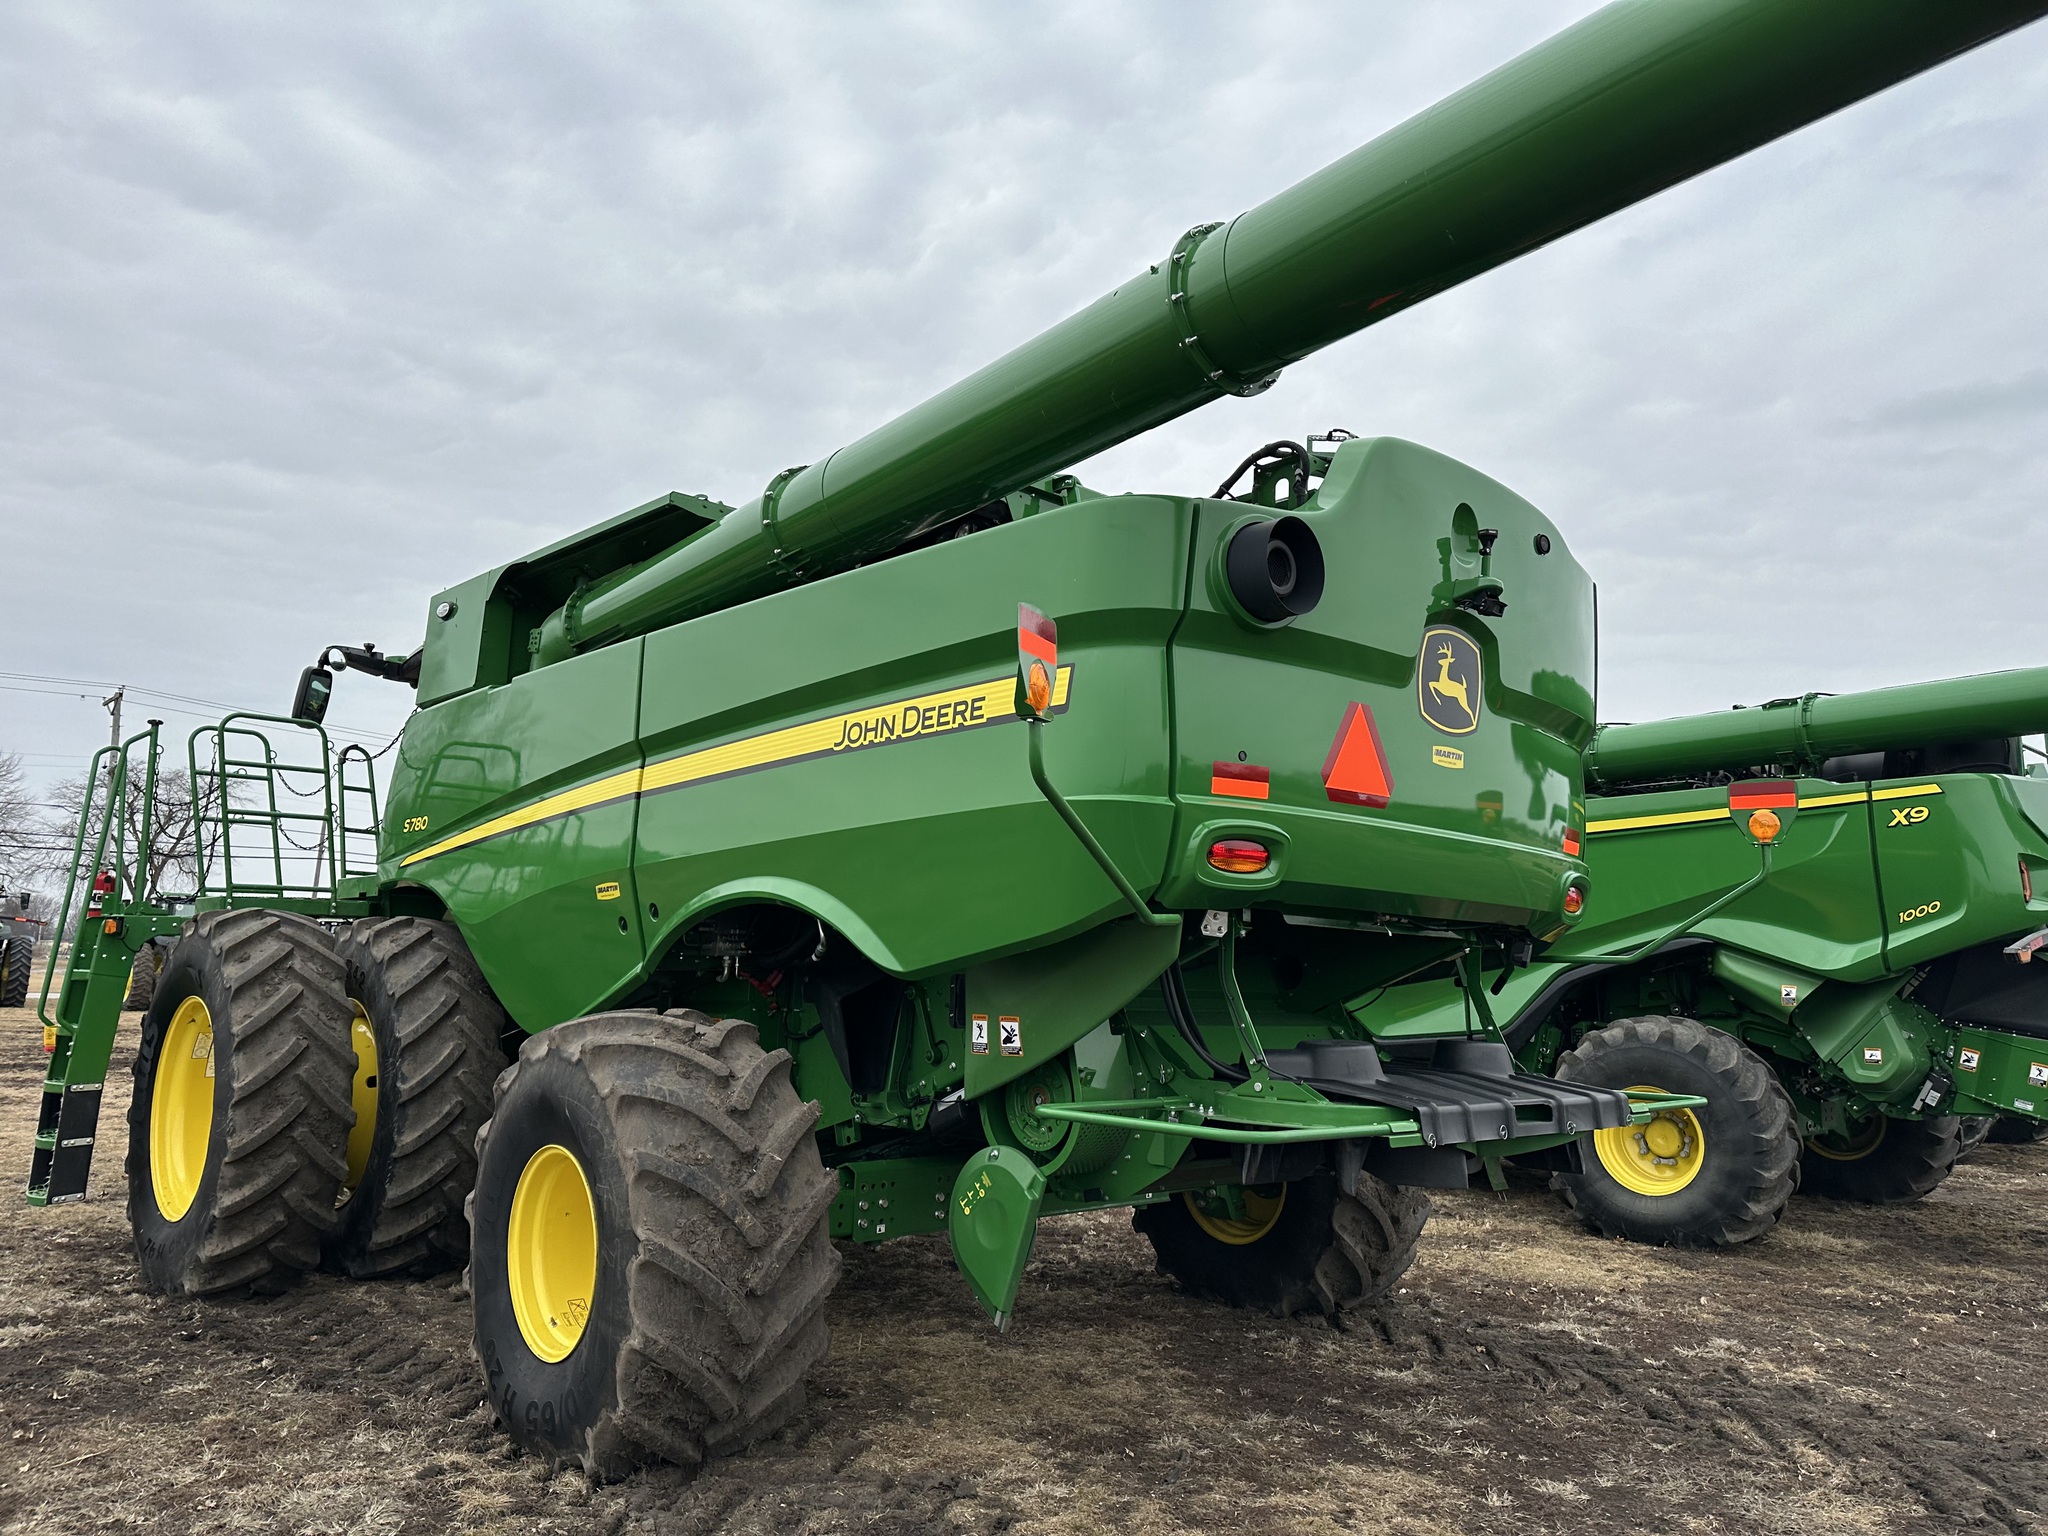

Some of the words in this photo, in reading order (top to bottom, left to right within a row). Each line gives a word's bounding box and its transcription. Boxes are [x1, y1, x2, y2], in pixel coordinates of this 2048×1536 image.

[833, 714, 897, 748] JOHN
[901, 696, 986, 735] DEERE
[1435, 748, 1463, 761] MARTIN
[403, 815, 429, 833] S780
[1888, 806, 1929, 827] X9
[1899, 901, 1941, 924] 1000
